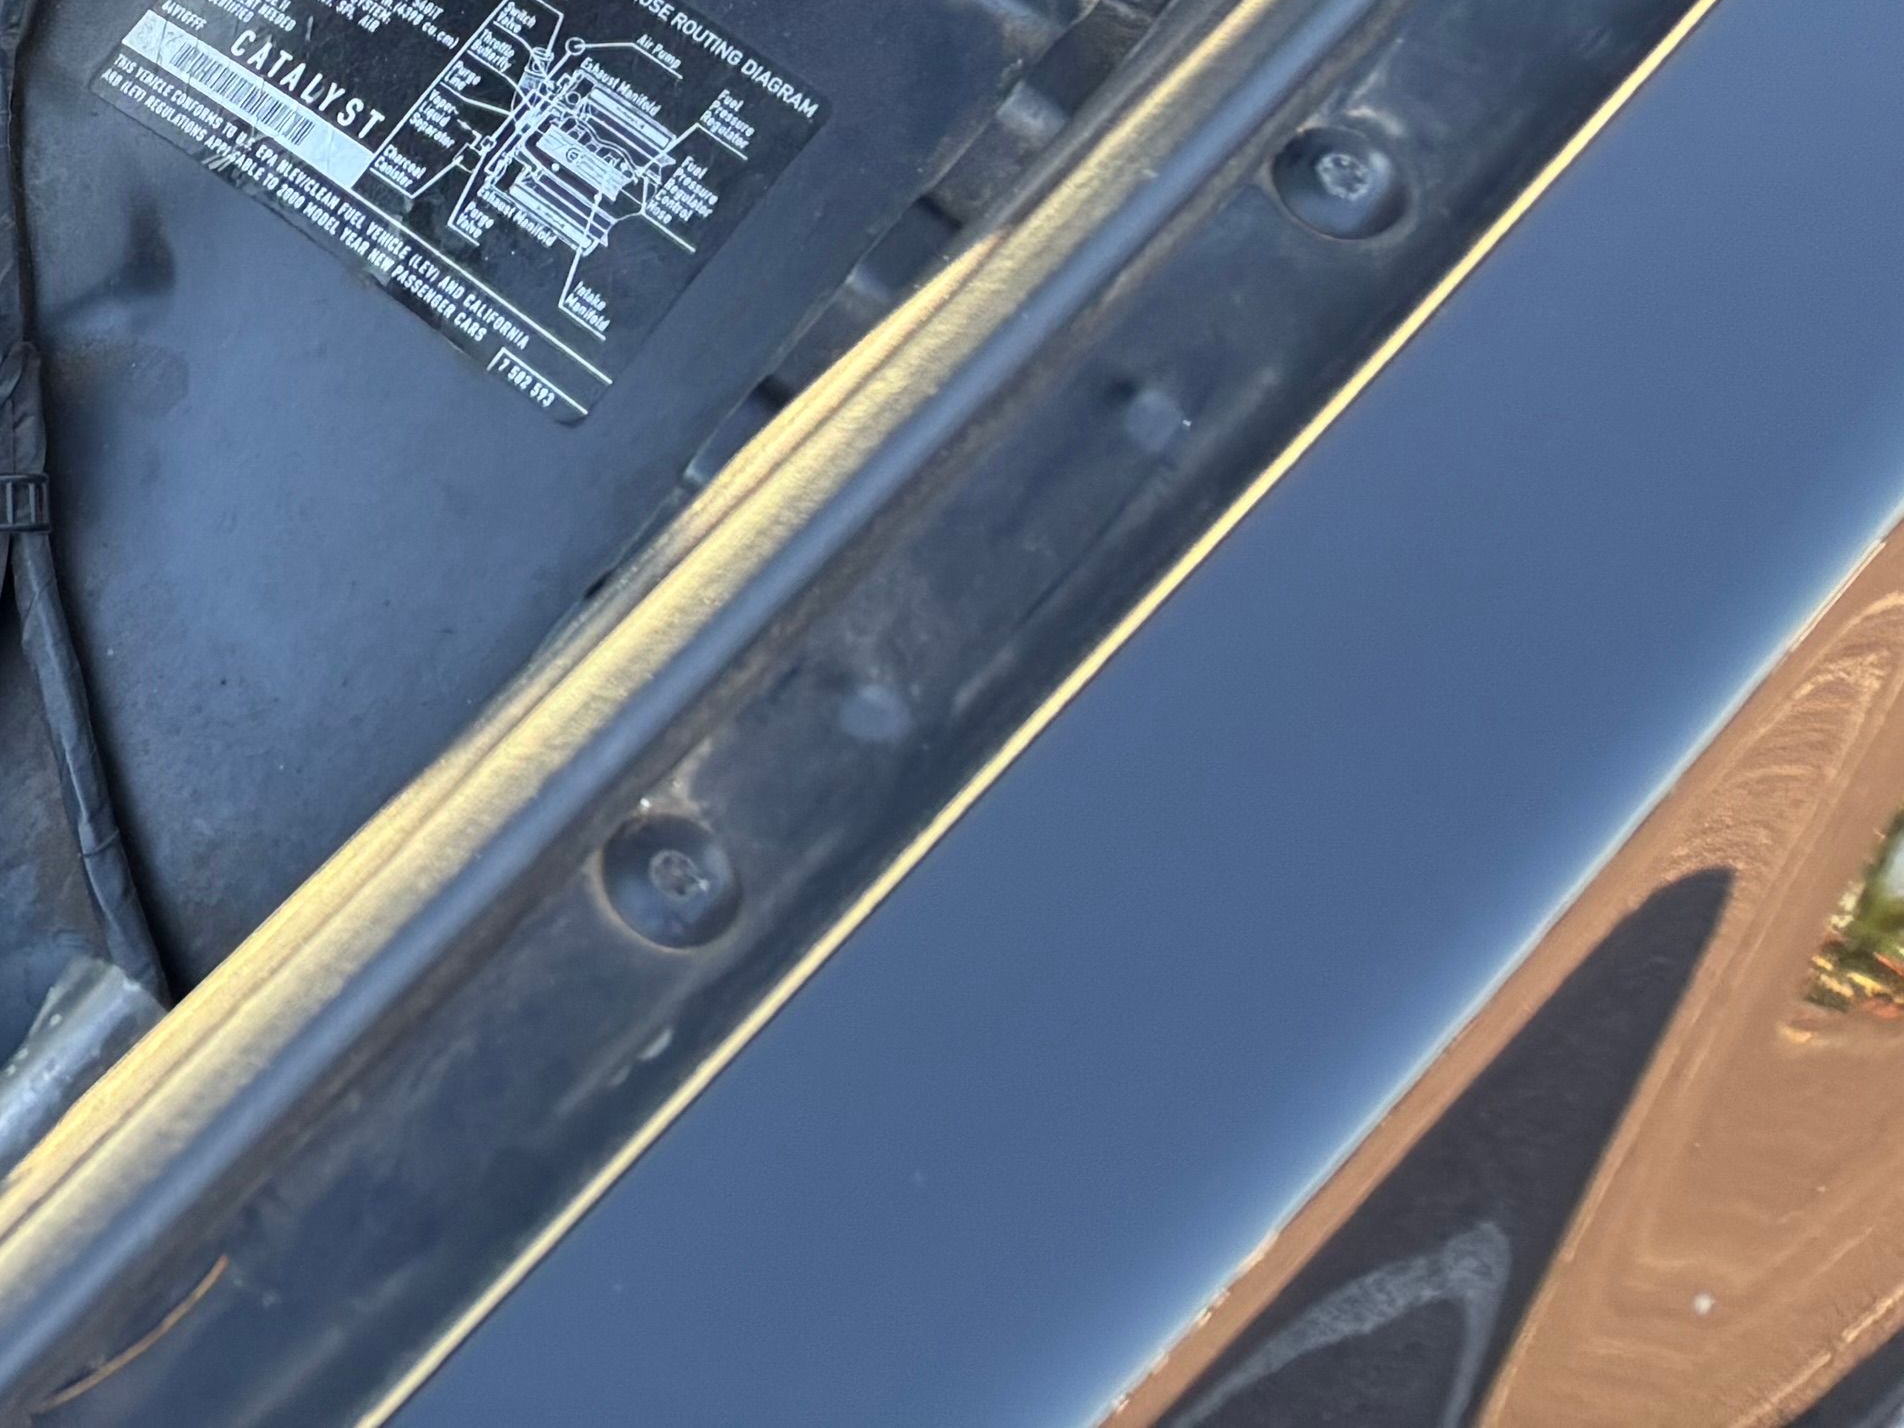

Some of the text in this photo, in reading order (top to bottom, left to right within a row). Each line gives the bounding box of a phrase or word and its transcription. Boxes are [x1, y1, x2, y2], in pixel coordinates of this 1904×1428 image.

[257, 2, 296, 32] NEEDED
[494, 11, 524, 34] Valve
[501, 0, 539, 28] Switch
[476, 28, 518, 59] Throttle
[635, 33, 684, 70] Air Pump
[449, 59, 484, 87] Purge
[667, 11, 746, 66] ROUTING
[736, 58, 823, 118] DIAGRAM
[227, 25, 386, 142] CATALYST
[578, 56, 662, 116] Exhaust Manifold
[715, 88, 745, 112] Fuel
[416, 100, 452, 129] Liquid
[696, 110, 753, 150] Regulator
[705, 99, 758, 137] Pressure
[371, 155, 415, 190] Canister
[380, 144, 427, 179] Charcoal
[679, 155, 709, 180] Fuel
[112, 51, 138, 74] THIS
[132, 64, 174, 98] VEHICLE
[168, 87, 224, 131] CONFORMS
[219, 121, 238, 139] TO
[253, 144, 280, 167] EPA
[335, 201, 368, 229] FUEL
[362, 221, 412, 260] VEHICLE
[406, 252, 442, 282] (LEV)
[436, 275, 466, 301] AND
[459, 293, 533, 350] CALIFORNIA
[660, 178, 715, 219] Regulator
[669, 168, 721, 206] Pressure
[142, 92, 209, 143] REGULATIONS
[260, 171, 281, 191] TO
[275, 182, 306, 209] 2000
[301, 201, 342, 235] MODEL
[336, 227, 370, 256] YEAR
[365, 247, 394, 273] NEW
[388, 265, 457, 319] PASSENGER
[451, 311, 488, 342] CARS
[461, 200, 497, 230] Purge
[474, 184, 558, 248] Exhaust Manifold
[643, 200, 674, 224] Hose
[651, 189, 695, 222] Control
[452, 213, 485, 239] Valve
[562, 292, 612, 332] Manifold
[571, 281, 610, 312] Intake
[495, 357, 510, 373] 7
[527, 382, 557, 408] 593
